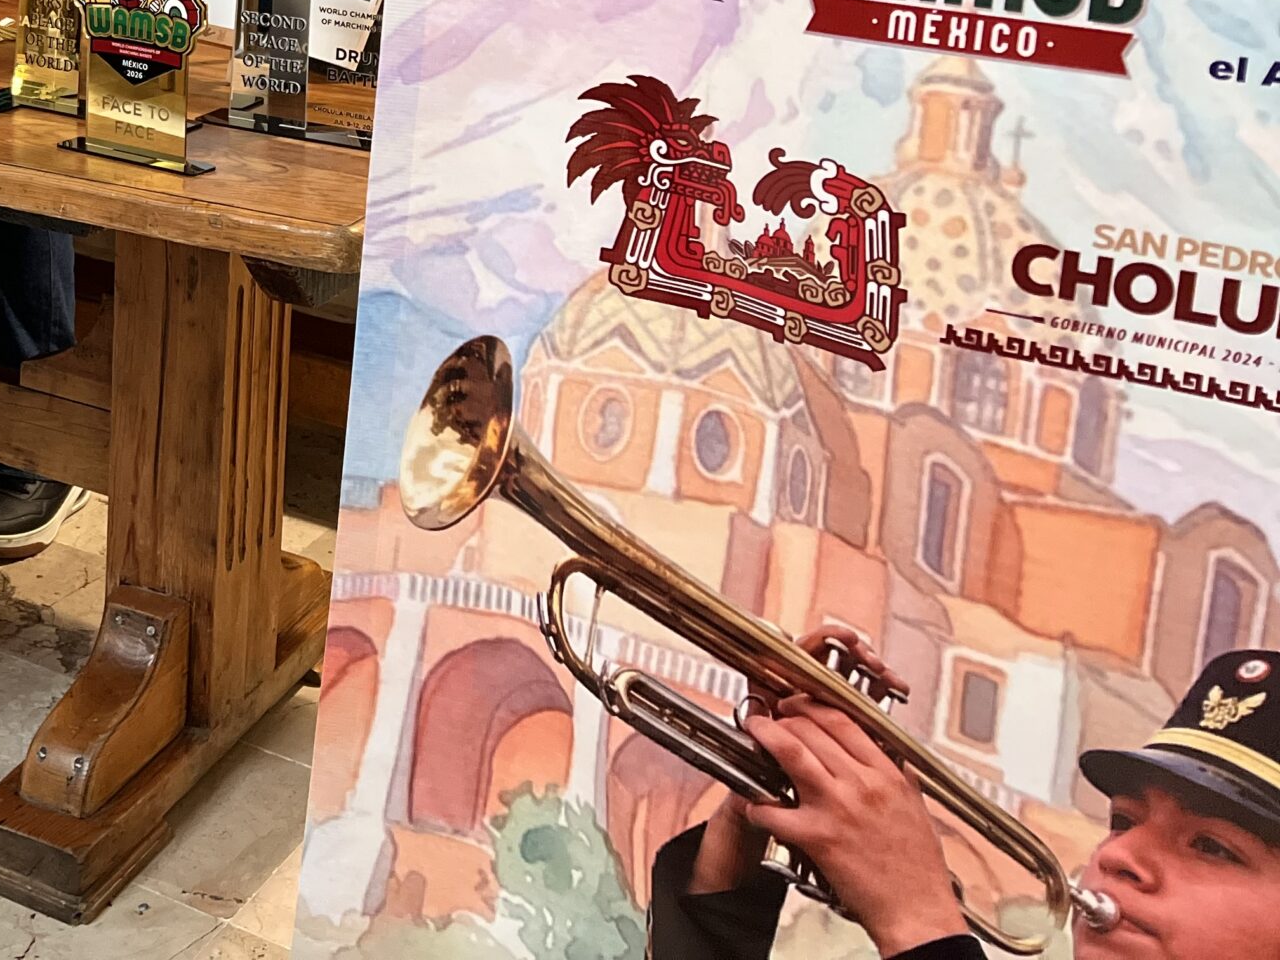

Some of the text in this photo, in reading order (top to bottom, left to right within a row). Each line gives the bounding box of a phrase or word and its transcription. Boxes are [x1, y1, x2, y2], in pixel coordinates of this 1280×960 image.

[241, 10, 306, 31] SECOND
[319, 6, 347, 17] WORLD
[30, 13, 75, 33] PLACE
[87, 5, 190, 53] WAMSB
[887, 9, 1038, 58] MÉXICO
[26, 32, 77, 53] OF THE
[248, 32, 299, 52] PLACE
[24, 52, 74, 72] WORLD
[243, 52, 303, 74] OF THE
[1209, 56, 1249, 83] el
[126, 69, 143, 79] 2026
[241, 74, 301, 95] WORLD
[327, 68, 377, 88] BATTL
[101, 96, 170, 122] FACE TO
[114, 121, 156, 141] FACE
[1092, 224, 1168, 260] SAN
[1011, 243, 1280, 340] CHOLU
[1050, 316, 1127, 341] GOBIERNO
[1131, 331, 1216, 359] MUNICIPAL
[1221, 348, 1263, 368] 2024
